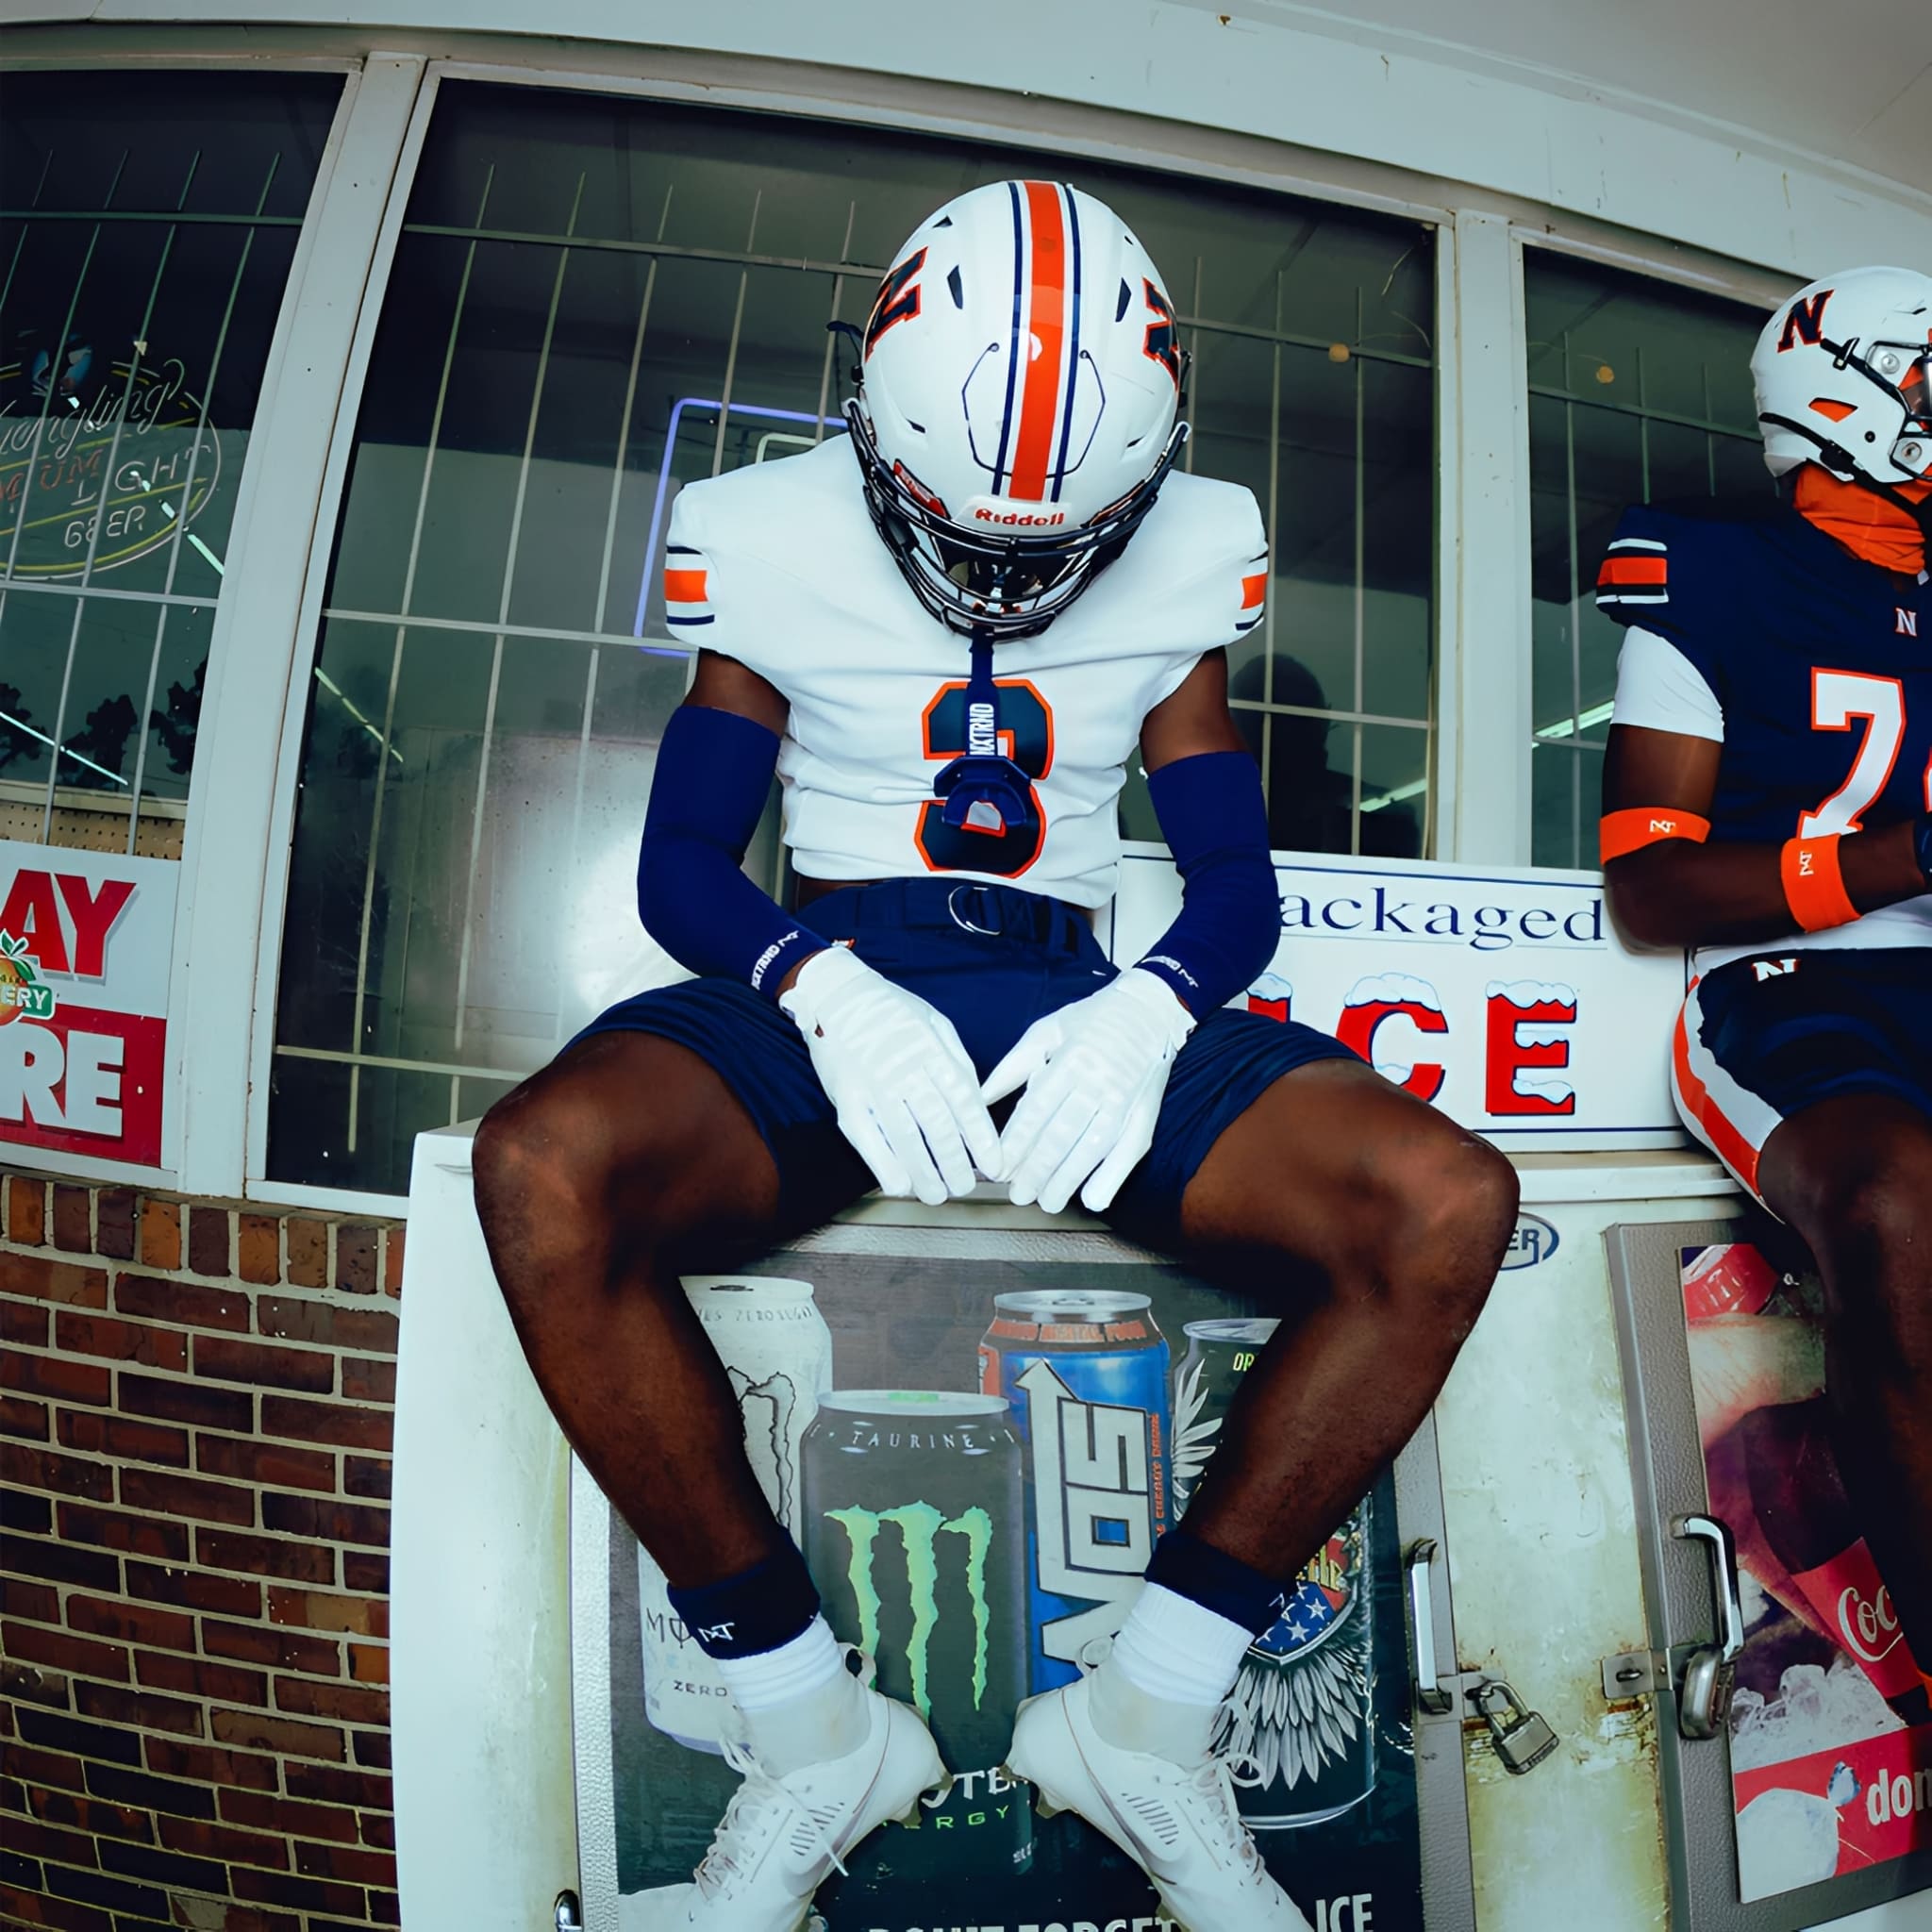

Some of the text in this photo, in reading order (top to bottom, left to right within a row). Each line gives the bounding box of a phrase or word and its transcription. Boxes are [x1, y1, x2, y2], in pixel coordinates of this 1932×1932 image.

[1777, 289, 1835, 354] N
[974, 508, 1065, 526] Riddell
[1895, 608, 1917, 637] N
[969, 703, 995, 756] NXTRND
[1796, 666, 1907, 840] 7
[1280, 887, 1607, 951] ackaged
[0, 1021, 125, 1138] RE
[852, 1430, 974, 1450] TAURINE
[674, 1679, 727, 1697] ZERO
